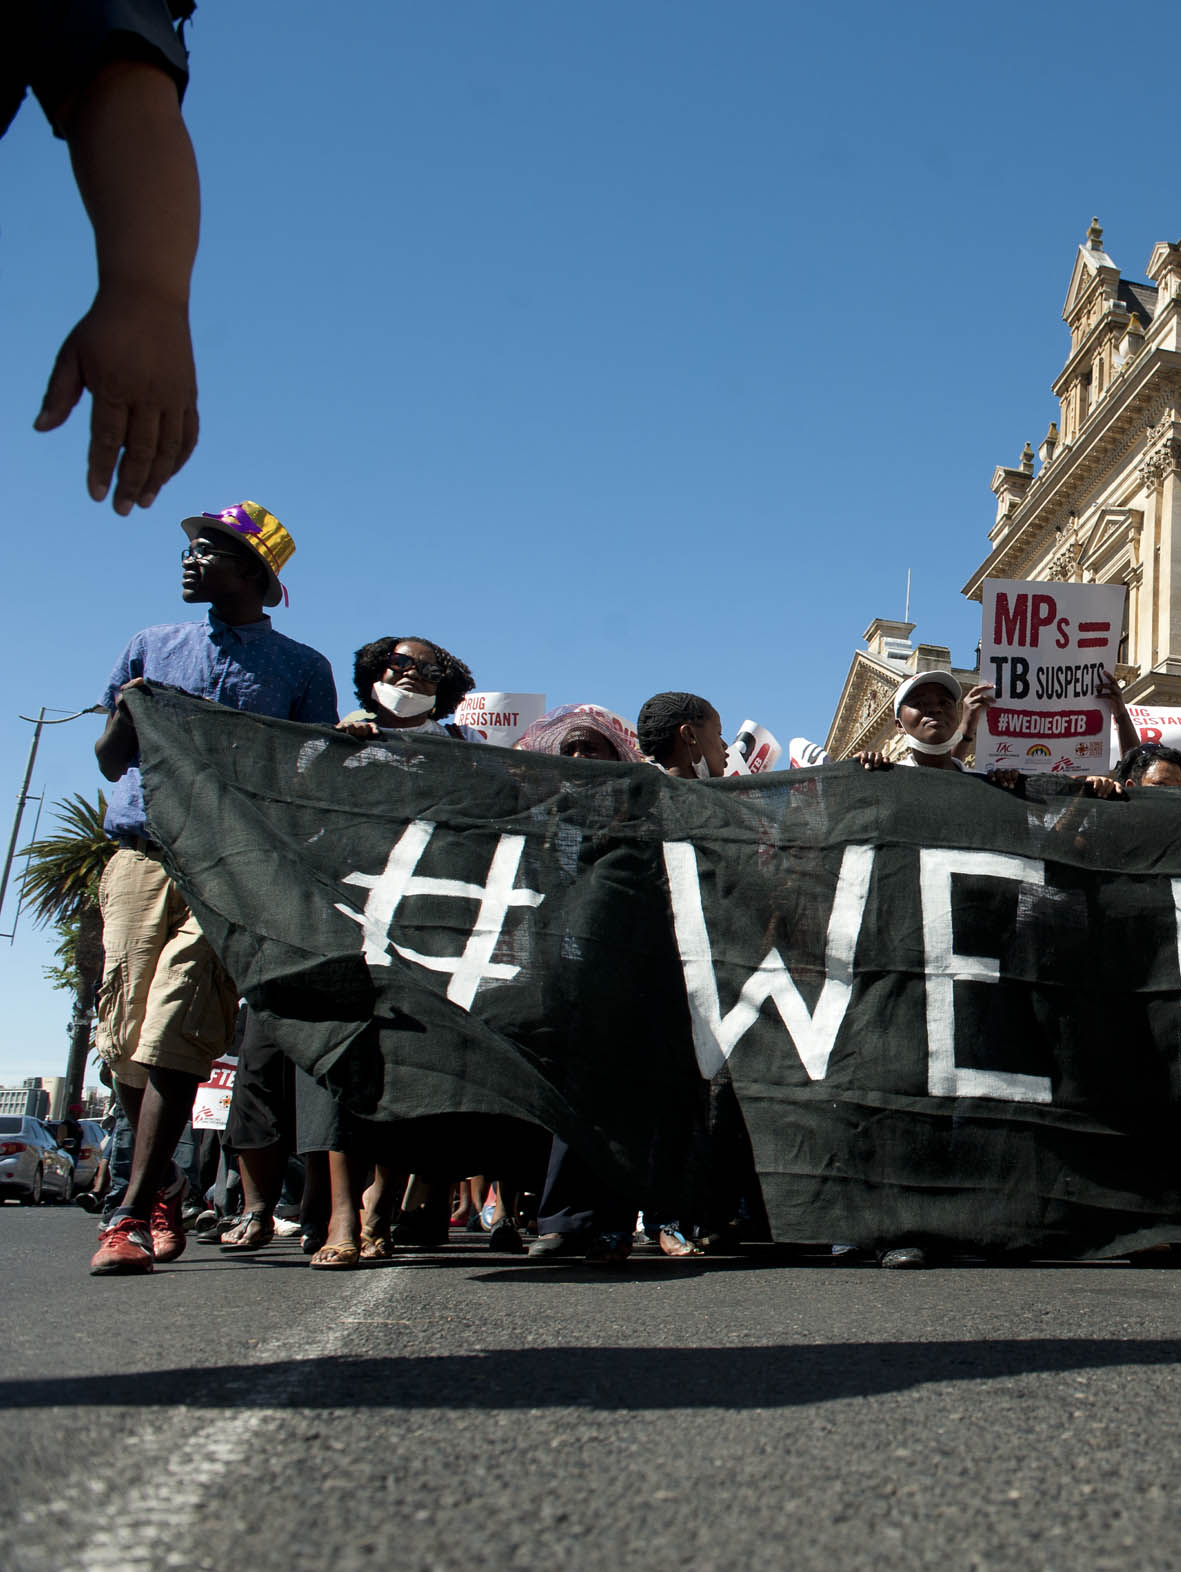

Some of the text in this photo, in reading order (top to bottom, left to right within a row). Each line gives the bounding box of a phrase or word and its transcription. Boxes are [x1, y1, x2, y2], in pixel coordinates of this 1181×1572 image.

[990, 656, 1030, 699] TB
[459, 712, 520, 727] RESISTANT
[1129, 708, 1151, 717] UG
